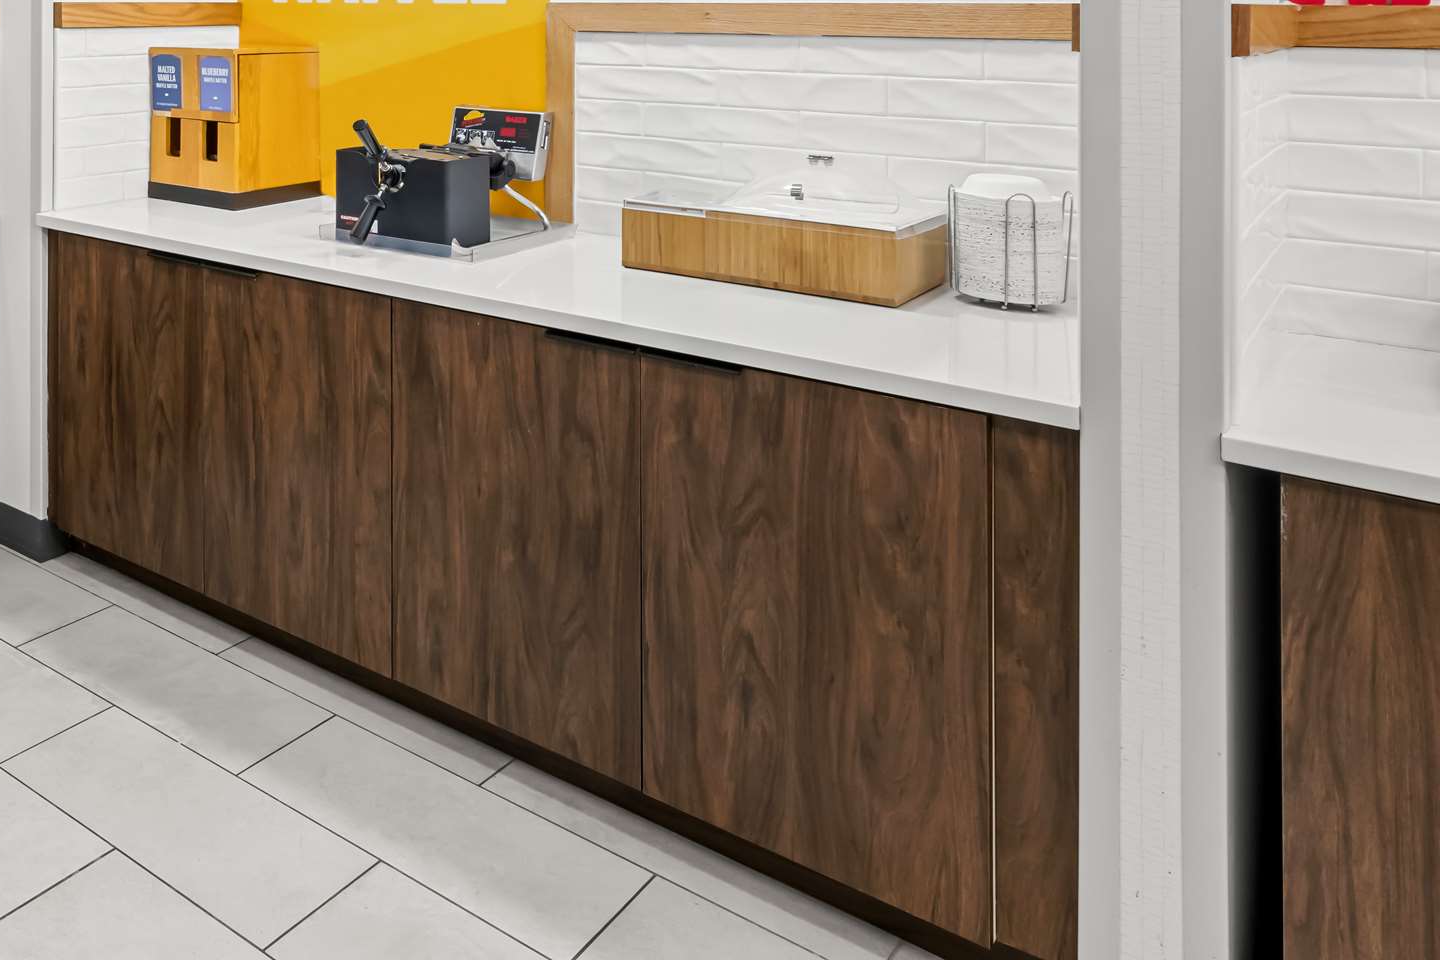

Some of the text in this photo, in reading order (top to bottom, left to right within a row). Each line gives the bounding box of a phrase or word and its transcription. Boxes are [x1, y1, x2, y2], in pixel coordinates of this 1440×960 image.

[157, 65, 176, 74] MALTED
[201, 67, 229, 77] BLUEBERRY
[157, 74, 177, 82] VANILLA
